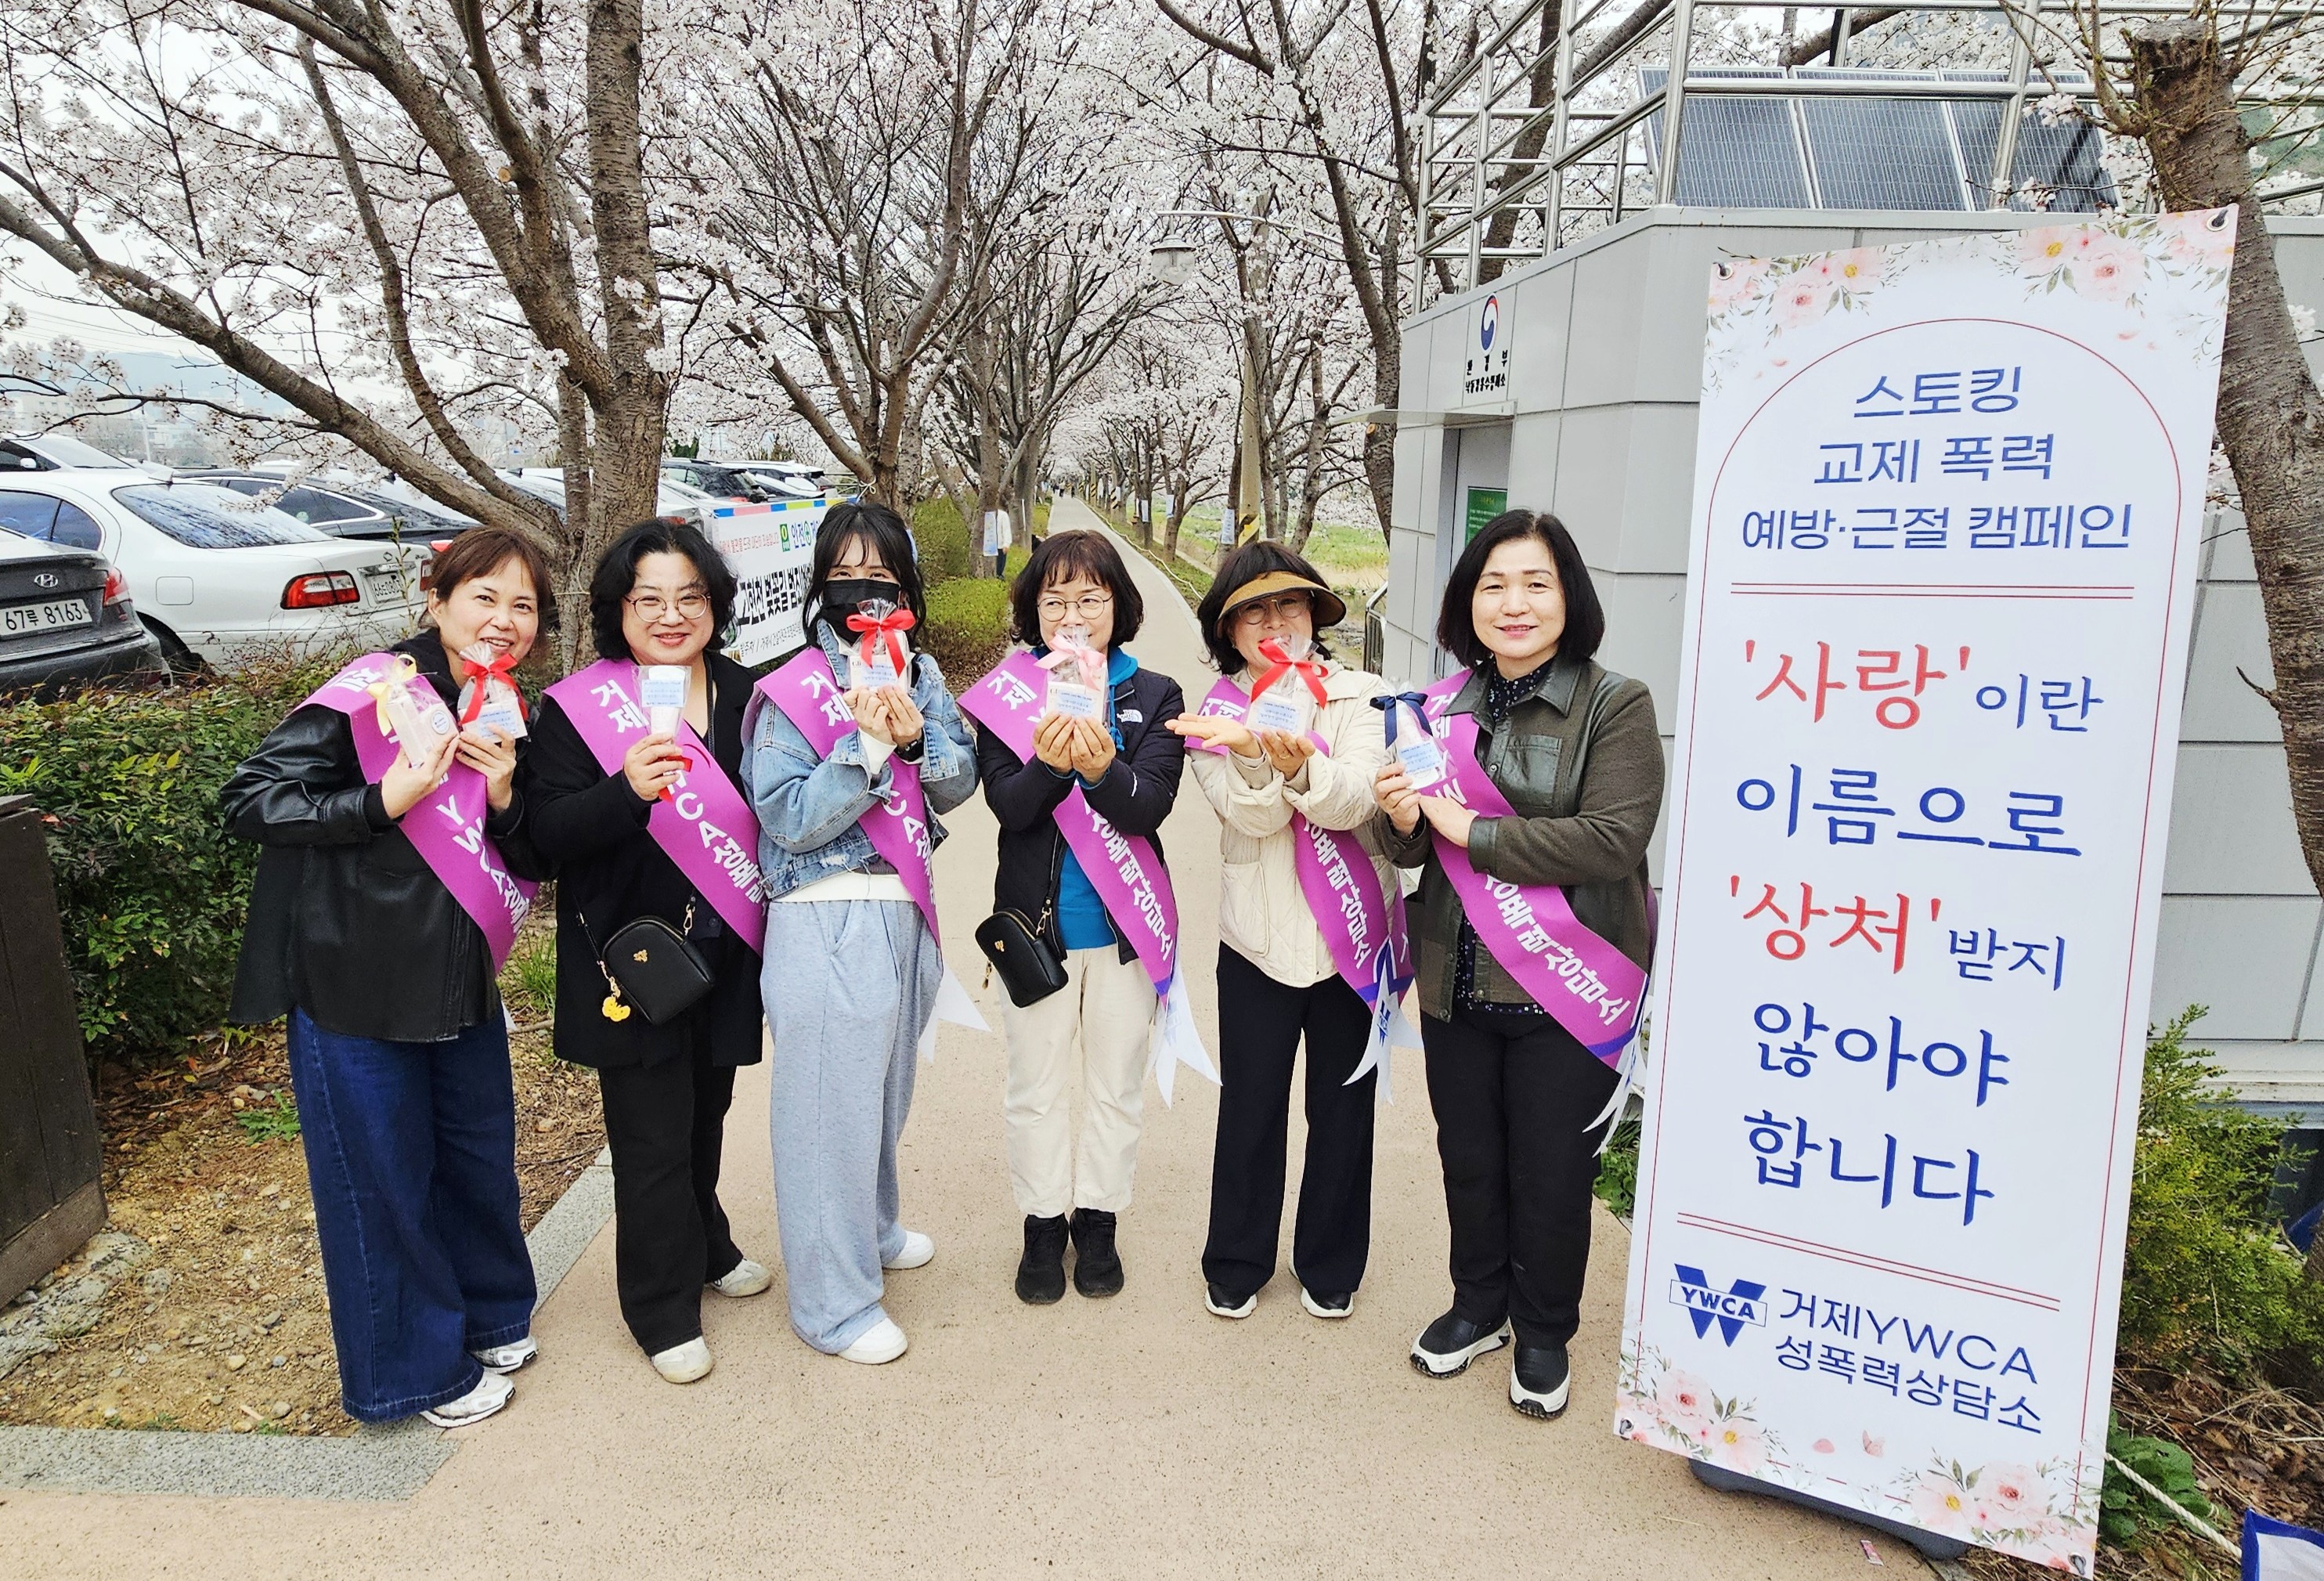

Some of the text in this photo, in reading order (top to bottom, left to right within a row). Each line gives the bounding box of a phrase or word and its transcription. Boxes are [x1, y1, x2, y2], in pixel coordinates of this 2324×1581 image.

[1853, 366, 2022, 418] 스토킹
[1813, 434, 2055, 484] 교제 폭력
[1742, 504, 2132, 550] 예방·근절 캠페인
[5, 602, 83, 631] 67루 8163
[1736, 763, 2083, 857] 이름으로
[1753, 1002, 2010, 1107] 않아야
[1743, 1109, 1995, 1226] 합니다
[1681, 1286, 1756, 1320] YWCA
[1781, 1289, 2037, 1384] 거제YWCA
[1776, 1336, 2041, 1434] 성폭력상담소
